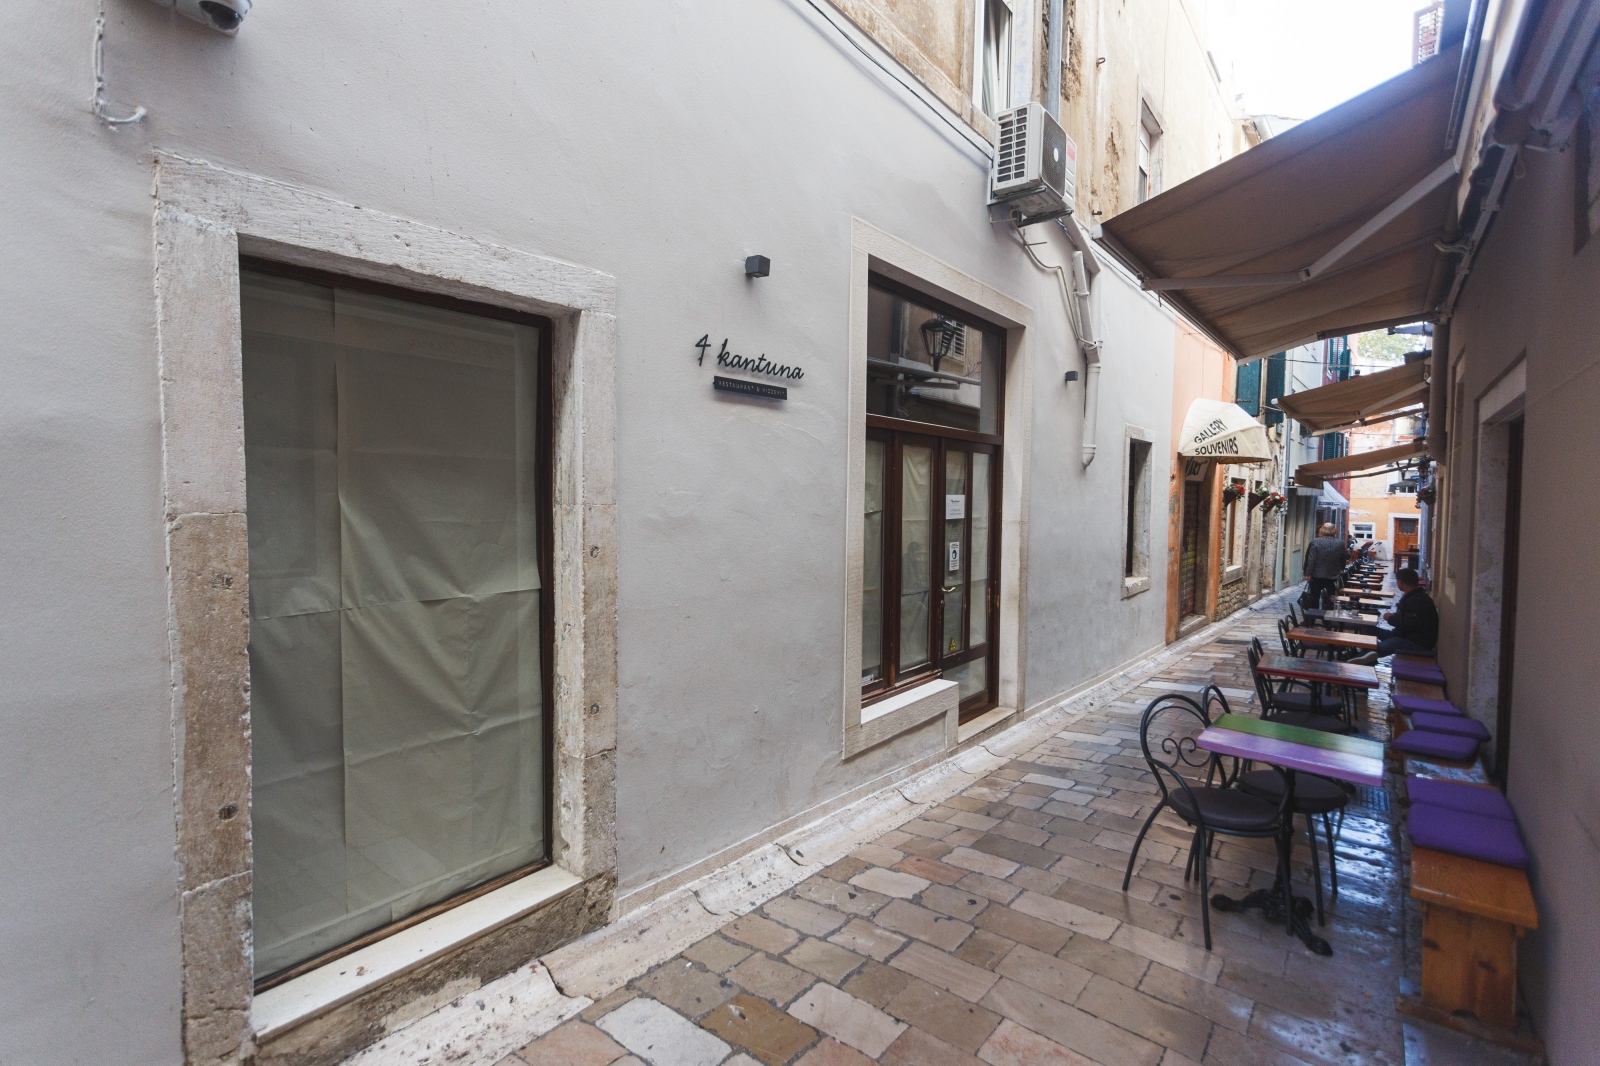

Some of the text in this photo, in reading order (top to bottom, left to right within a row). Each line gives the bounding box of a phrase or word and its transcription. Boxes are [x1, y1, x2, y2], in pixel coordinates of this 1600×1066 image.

[694, 333, 804, 380] 4 kantuna
[718, 380, 754, 391] RESTAURANT
[1194, 417, 1228, 444] GALLERY
[1194, 436, 1239, 456] SOUVENIRS
